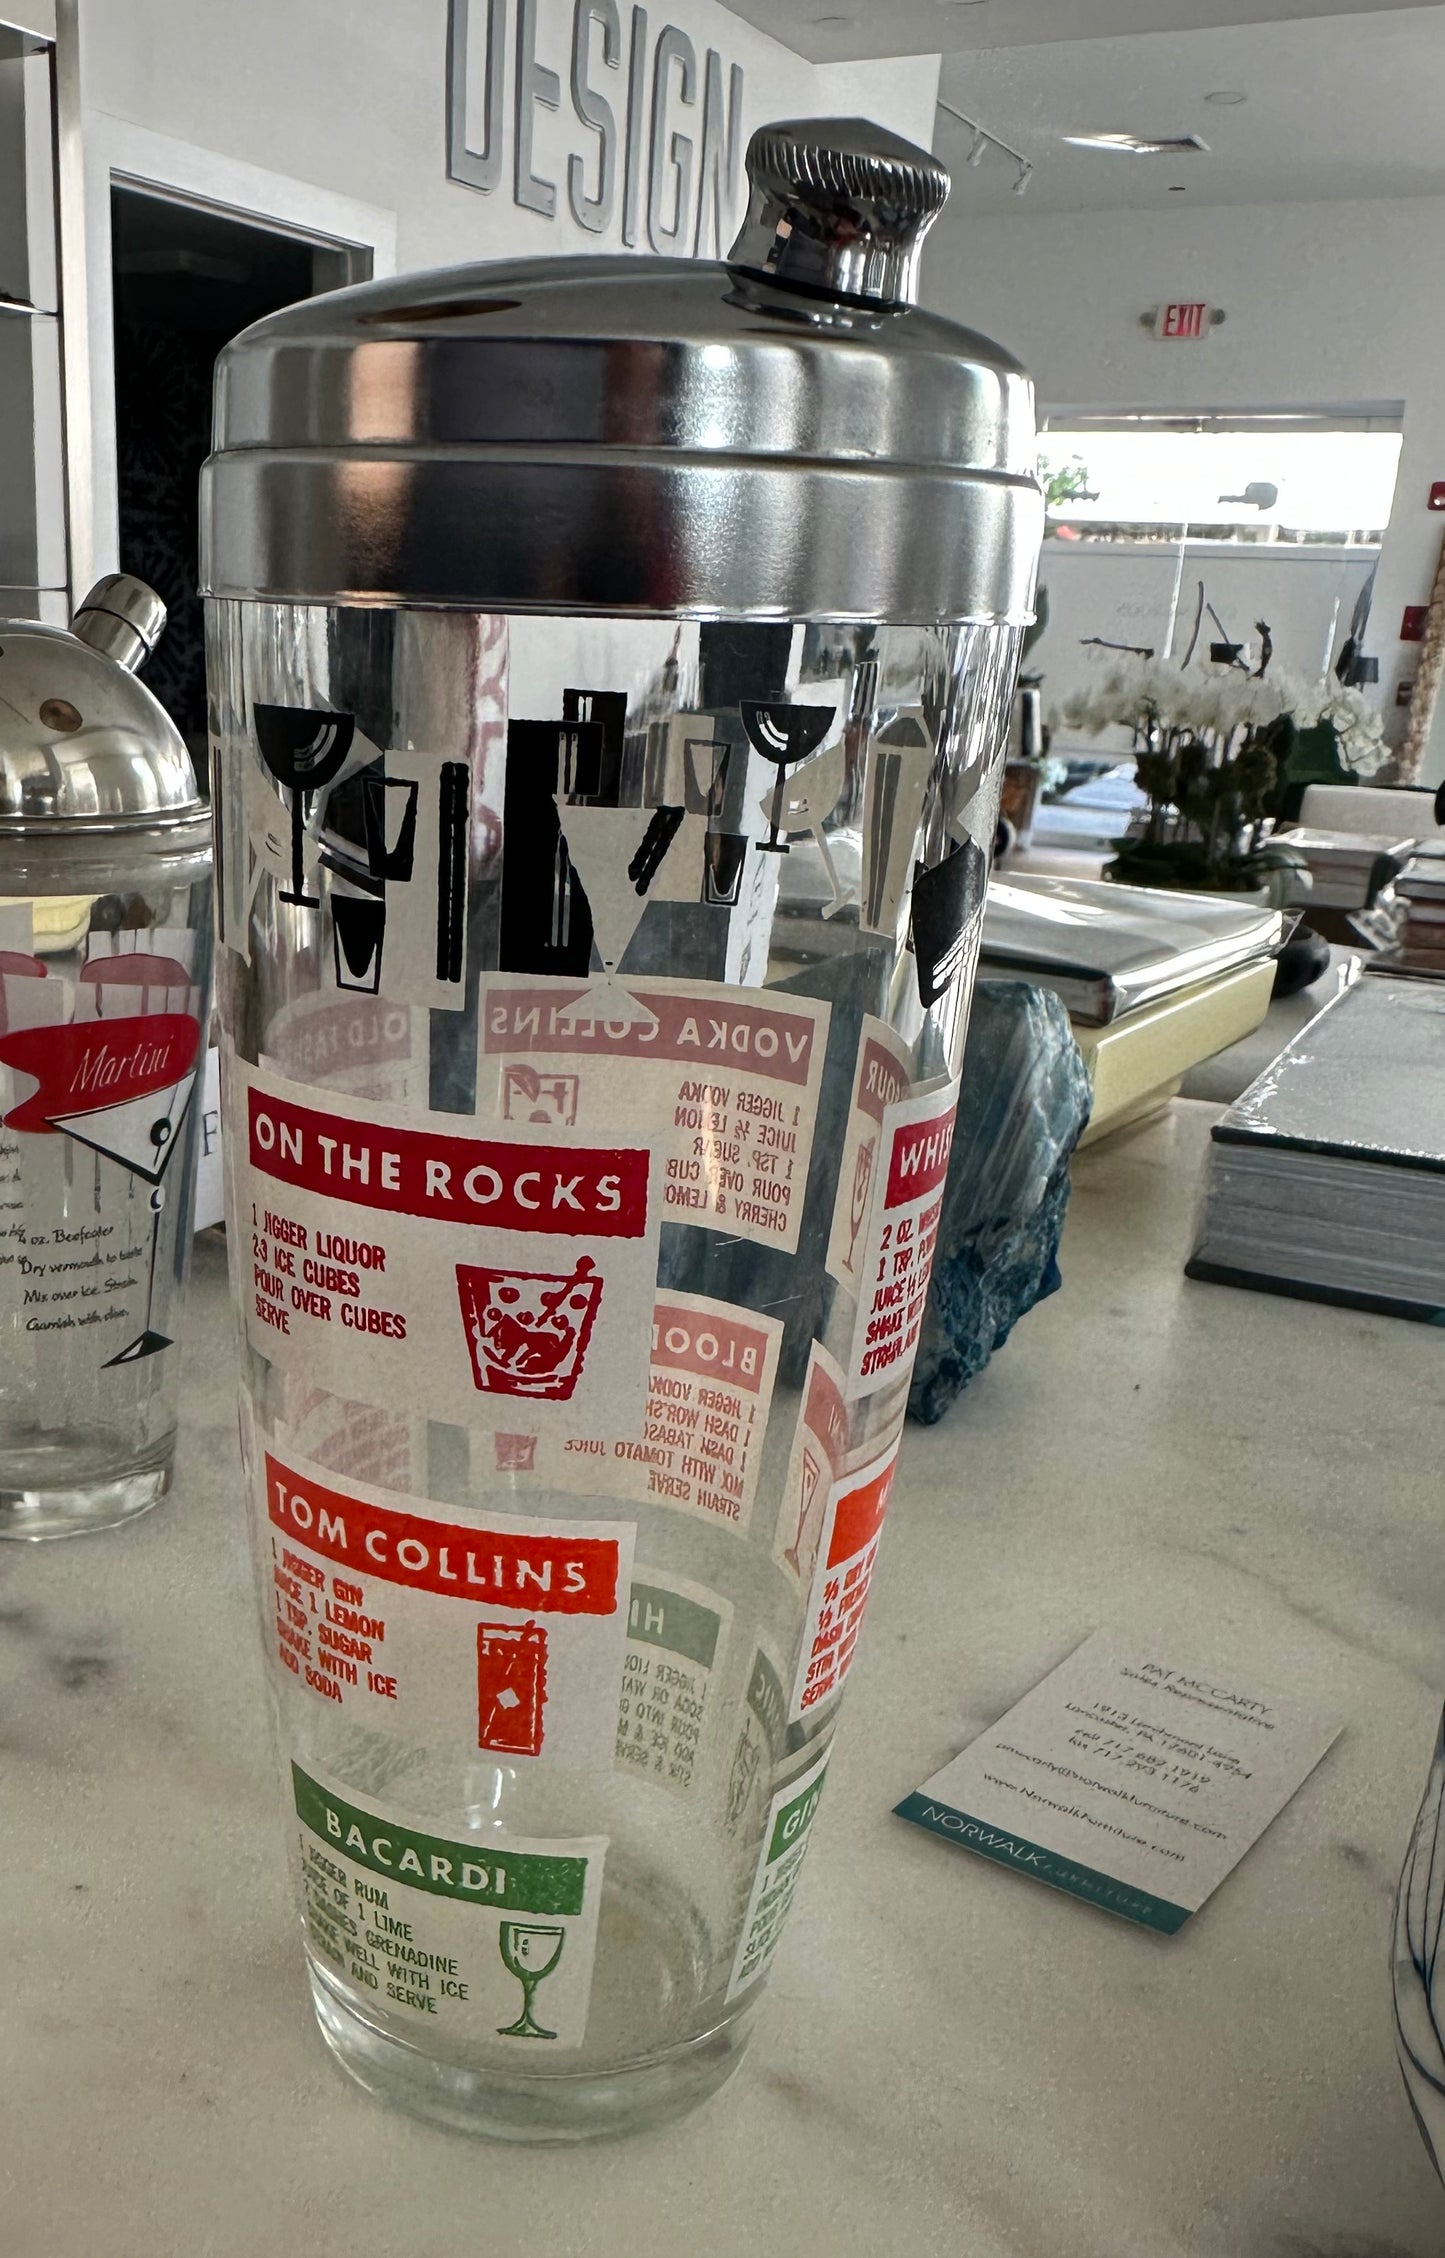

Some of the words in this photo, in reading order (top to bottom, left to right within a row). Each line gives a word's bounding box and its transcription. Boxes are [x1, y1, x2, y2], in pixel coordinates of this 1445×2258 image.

[445, 0, 744, 259] DESIGN
[1162, 304, 1206, 336] EXIT
[69, 1034, 174, 1093] Martini
[256, 1113, 302, 1166] ON
[318, 1136, 400, 1190] THE
[426, 1160, 621, 1211] ROCKS
[252, 1203, 258, 1226] 1
[264, 1211, 308, 1250] JIGGER
[316, 1231, 386, 1272] LIQUOR
[880, 1224, 893, 1251] 2
[21, 1261, 46, 1277] Dry
[275, 1247, 296, 1277] ICE
[303, 1259, 360, 1298] CUBES
[877, 1257, 886, 1281] 1
[52, 1291, 78, 1301] over
[254, 1264, 284, 1302] POUR
[292, 1285, 331, 1321] OVER
[341, 1303, 407, 1339] CUBES
[256, 1294, 290, 1335] SERVE
[275, 1481, 348, 1549] TOM
[365, 1530, 587, 1593] COLLINS
[333, 1578, 363, 1607] GIN
[326, 1599, 385, 1641] LEMON
[318, 1623, 372, 1665] SUGAR
[305, 1665, 342, 1703] SODA
[318, 1647, 358, 1686] WITH
[367, 1671, 397, 1700] ICE
[326, 1808, 507, 1894] BACARDI
[922, 1805, 1046, 1867] NORWALK
[355, 1879, 389, 1911] RUM
[374, 1911, 413, 1942] LIME
[366, 1930, 459, 1976] GRENADINE
[386, 1982, 438, 2014] SERVE
[387, 1961, 429, 1990] WITH
[441, 1980, 469, 2000] ICE
